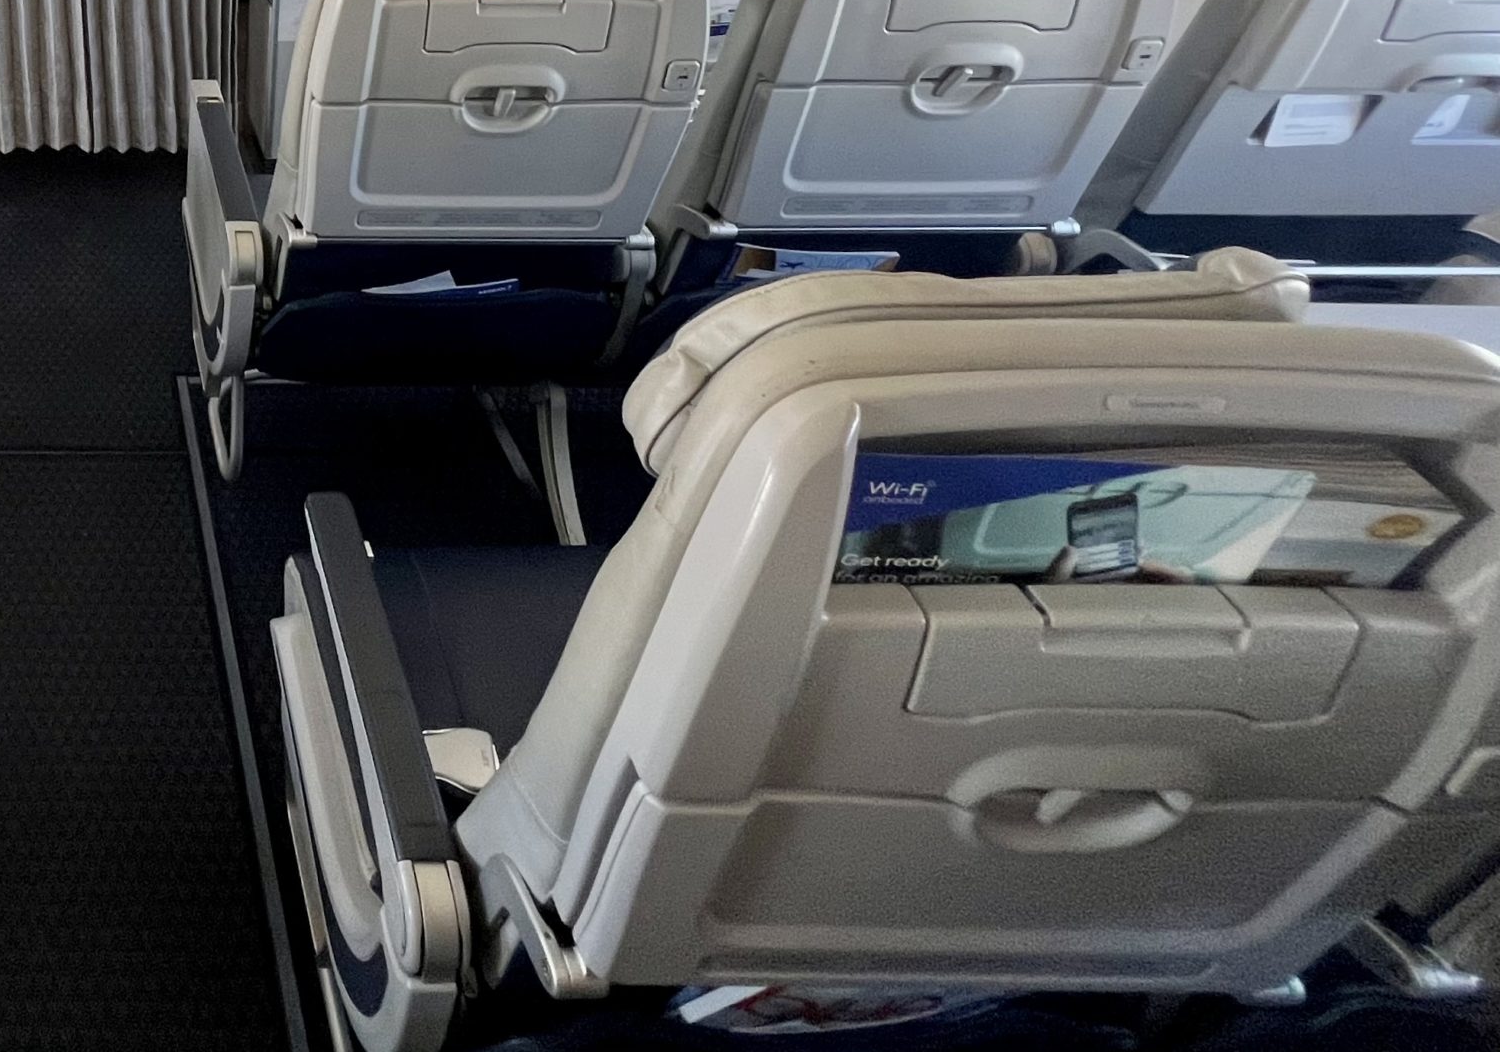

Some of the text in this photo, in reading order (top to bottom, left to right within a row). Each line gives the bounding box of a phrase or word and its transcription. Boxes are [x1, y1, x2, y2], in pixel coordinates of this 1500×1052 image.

[869, 480, 929, 497] Wi-Fi
[840, 553, 951, 571] Get ready
